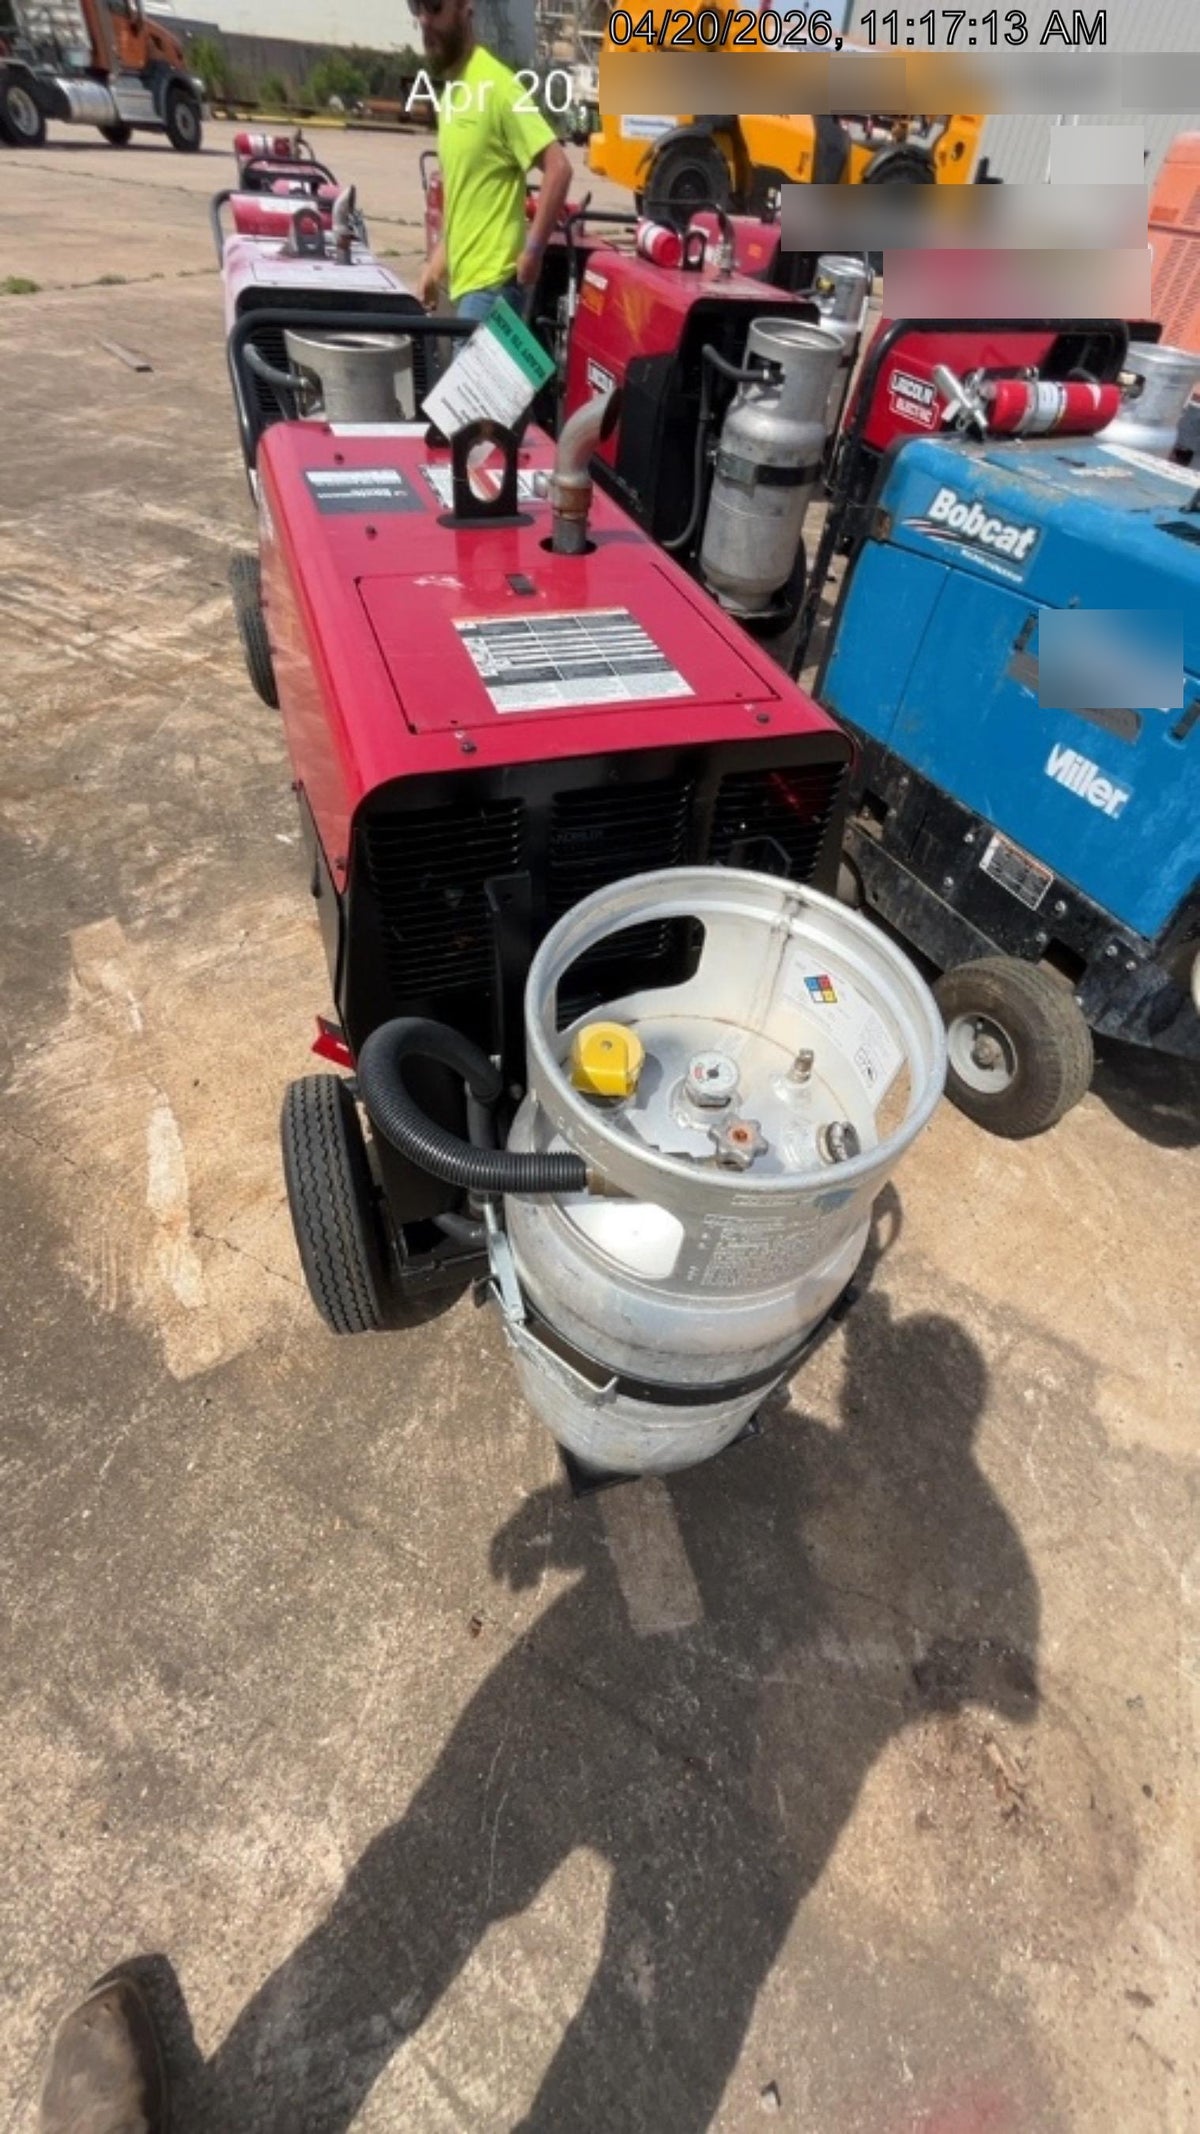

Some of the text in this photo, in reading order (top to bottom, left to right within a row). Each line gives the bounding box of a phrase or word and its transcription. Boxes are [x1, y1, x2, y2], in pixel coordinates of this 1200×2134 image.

[891, 372, 933, 406] LINCOLN
[895, 397, 933, 423] ELECTRIC
[928, 487, 1037, 559] Bobcat
[1045, 742, 1129, 816] Miller
